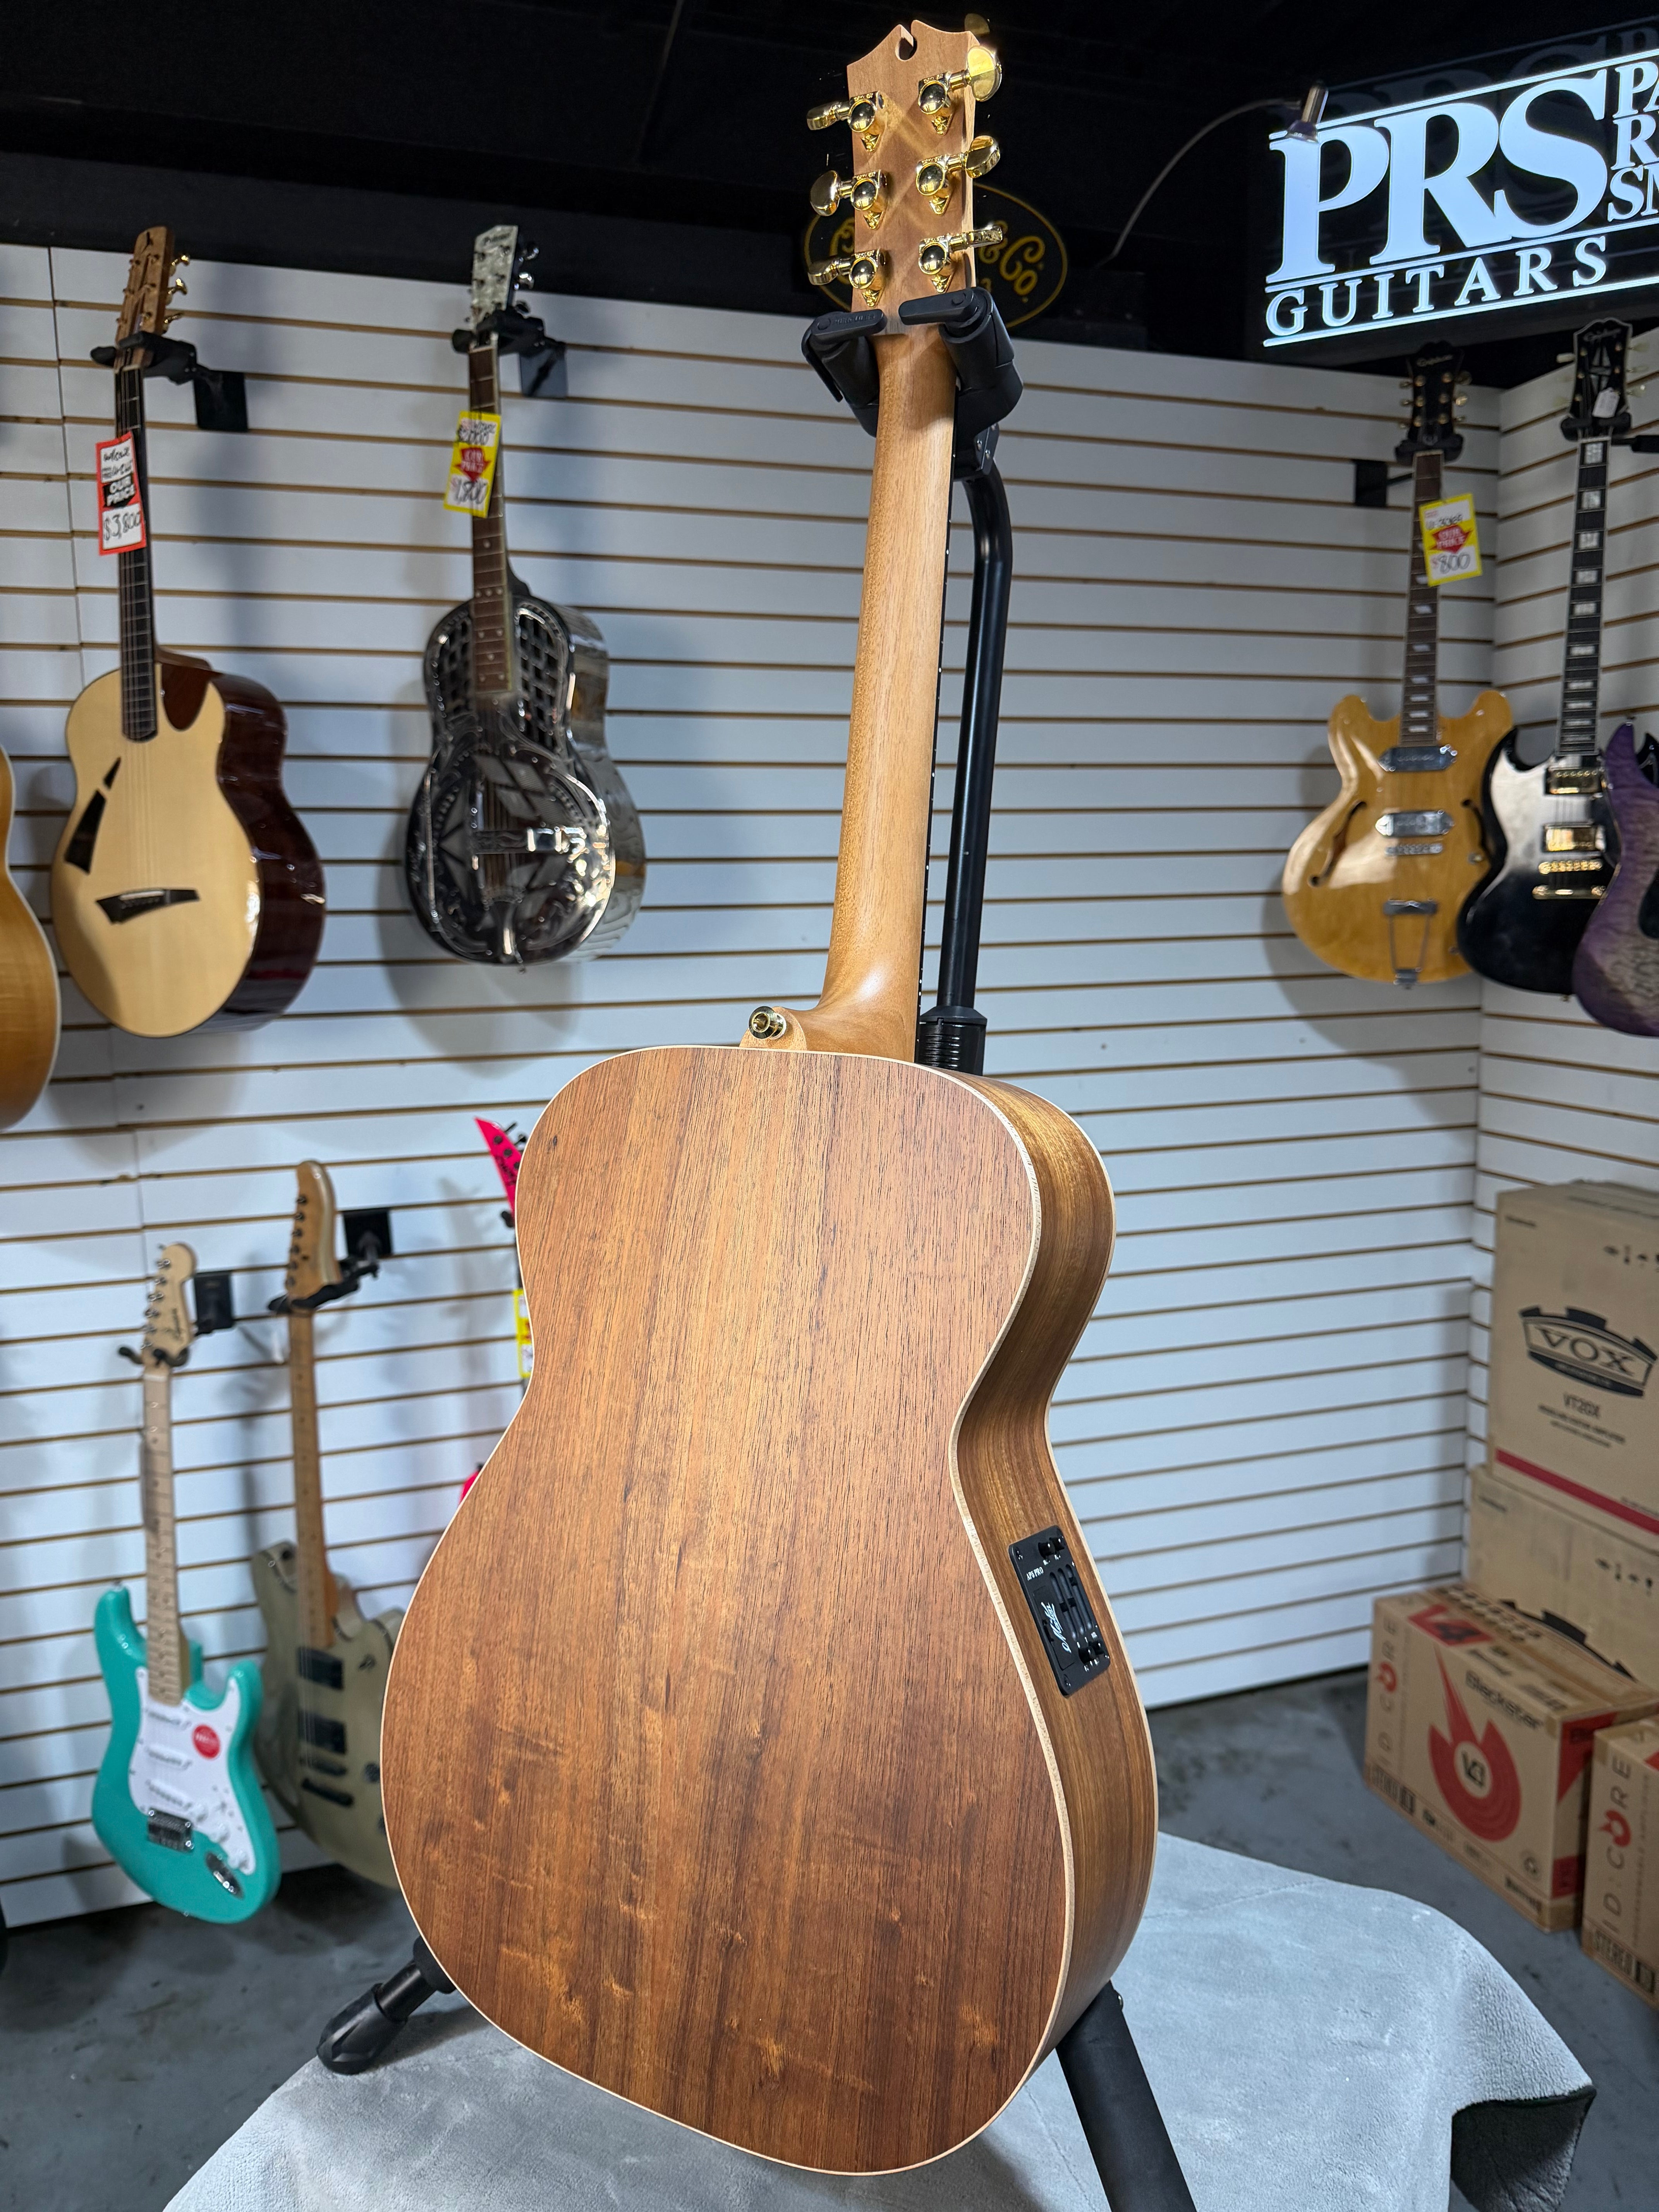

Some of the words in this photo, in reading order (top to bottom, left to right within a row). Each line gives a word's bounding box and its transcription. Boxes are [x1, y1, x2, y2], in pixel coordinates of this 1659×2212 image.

[1265, 69, 1607, 283] PRS
[1266, 236, 1606, 336] GUITARS
[106, 485, 135, 507] PRICE
[109, 476, 132, 494] OUR
[1534, 1326, 1635, 1377] VOX
[1033, 1566, 1044, 1577] PRO
[1041, 1601, 1072, 1654] Maton
[1465, 1670, 1543, 1729] Blackstar
